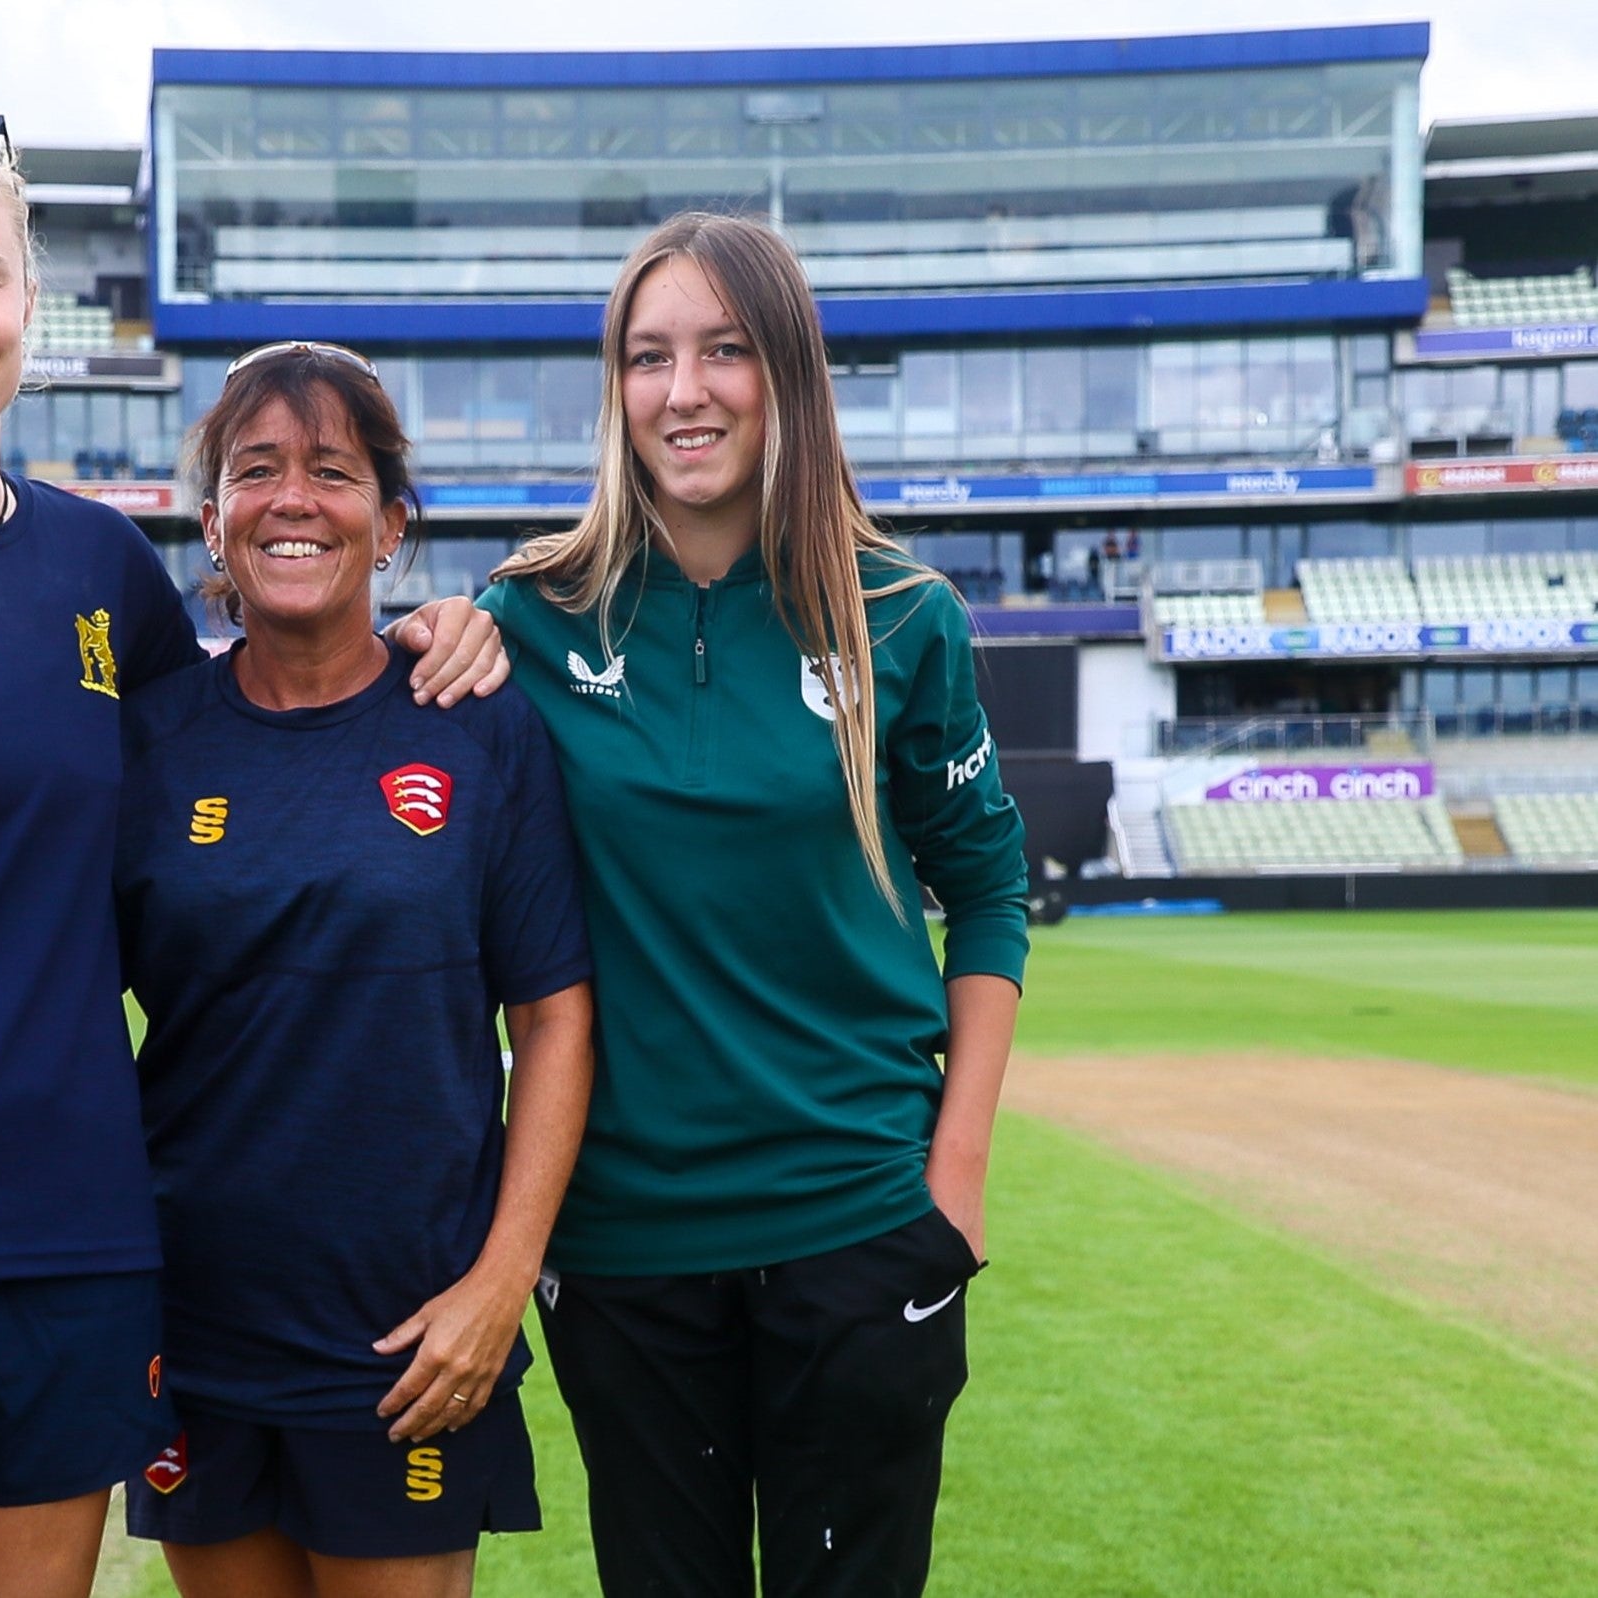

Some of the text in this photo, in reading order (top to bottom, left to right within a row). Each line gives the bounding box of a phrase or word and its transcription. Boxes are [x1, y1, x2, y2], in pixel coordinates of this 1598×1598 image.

[1173, 626, 1270, 655] RADOX
[1321, 623, 1422, 652] RADOX
[1470, 620, 1572, 649] RADOX
[1229, 766, 1420, 799] cinch cinch
